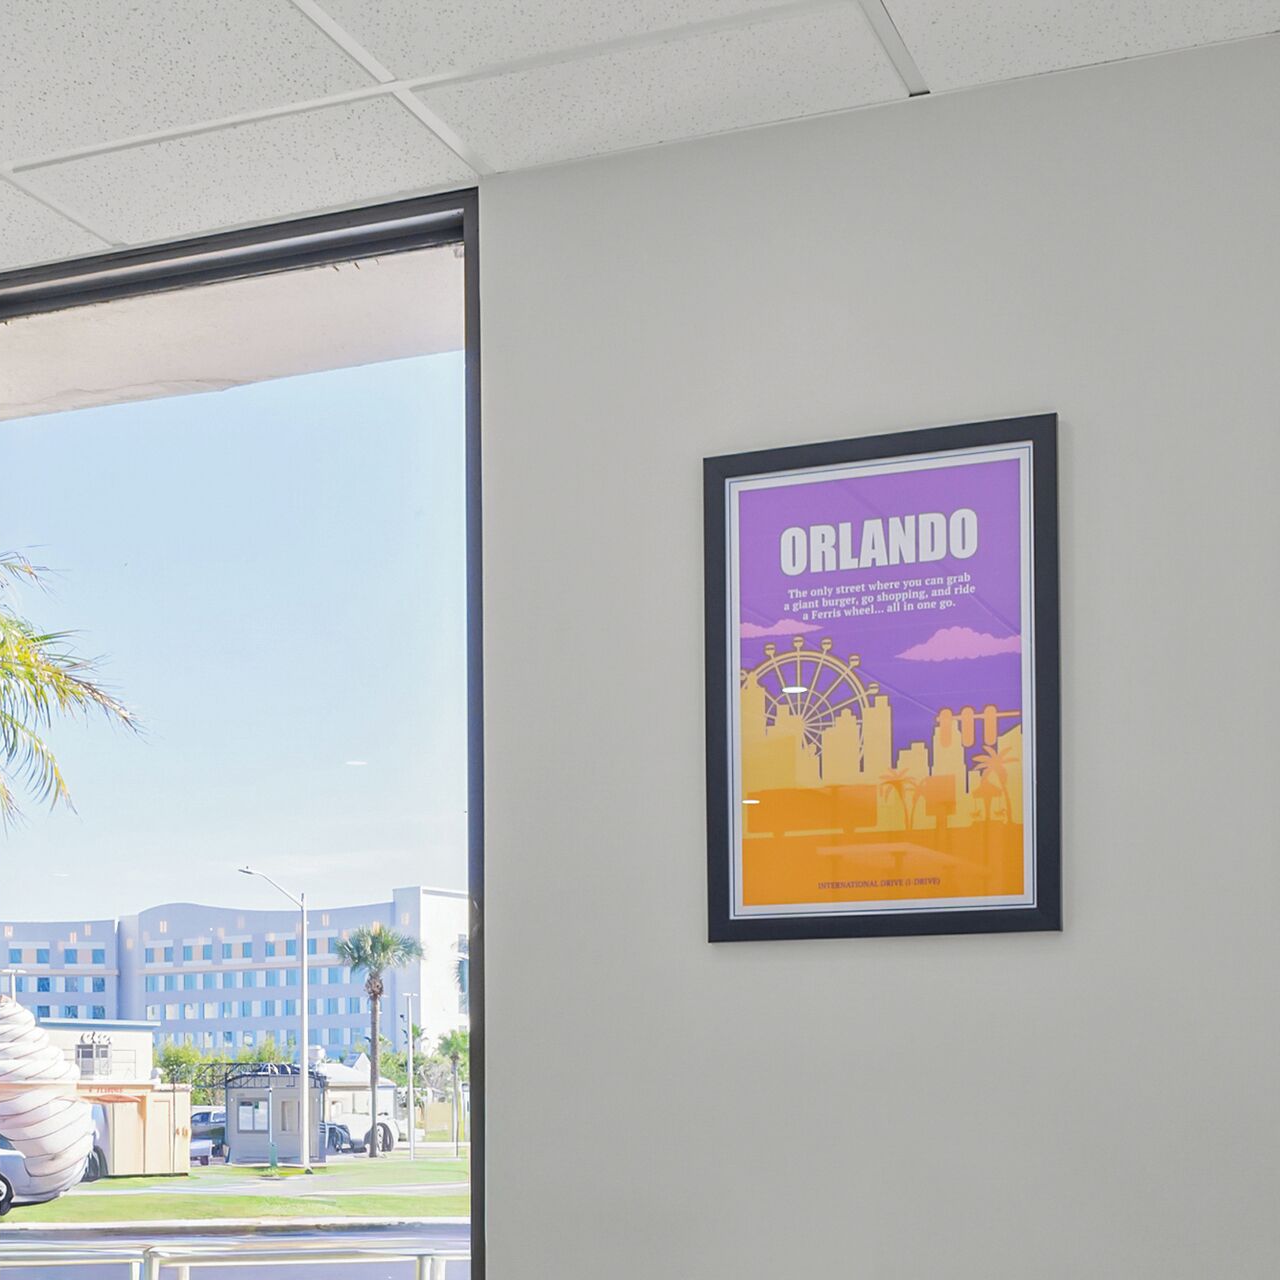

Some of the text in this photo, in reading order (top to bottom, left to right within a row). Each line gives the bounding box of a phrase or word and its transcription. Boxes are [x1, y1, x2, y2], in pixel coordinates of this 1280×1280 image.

[780, 508, 978, 576] ORLANDO
[783, 583, 976, 612] a giant burger, go shopping, and ride
[787, 572, 971, 599] The only street where you can grab
[811, 608, 841, 620] Ferris
[844, 604, 884, 616] wheel...
[886, 601, 900, 613] all
[903, 601, 914, 611] in
[917, 600, 937, 610] one
[939, 599, 956, 610] go.
[817, 880, 880, 889] INTERNATIONAL
[880, 879, 904, 888] DRIVE
